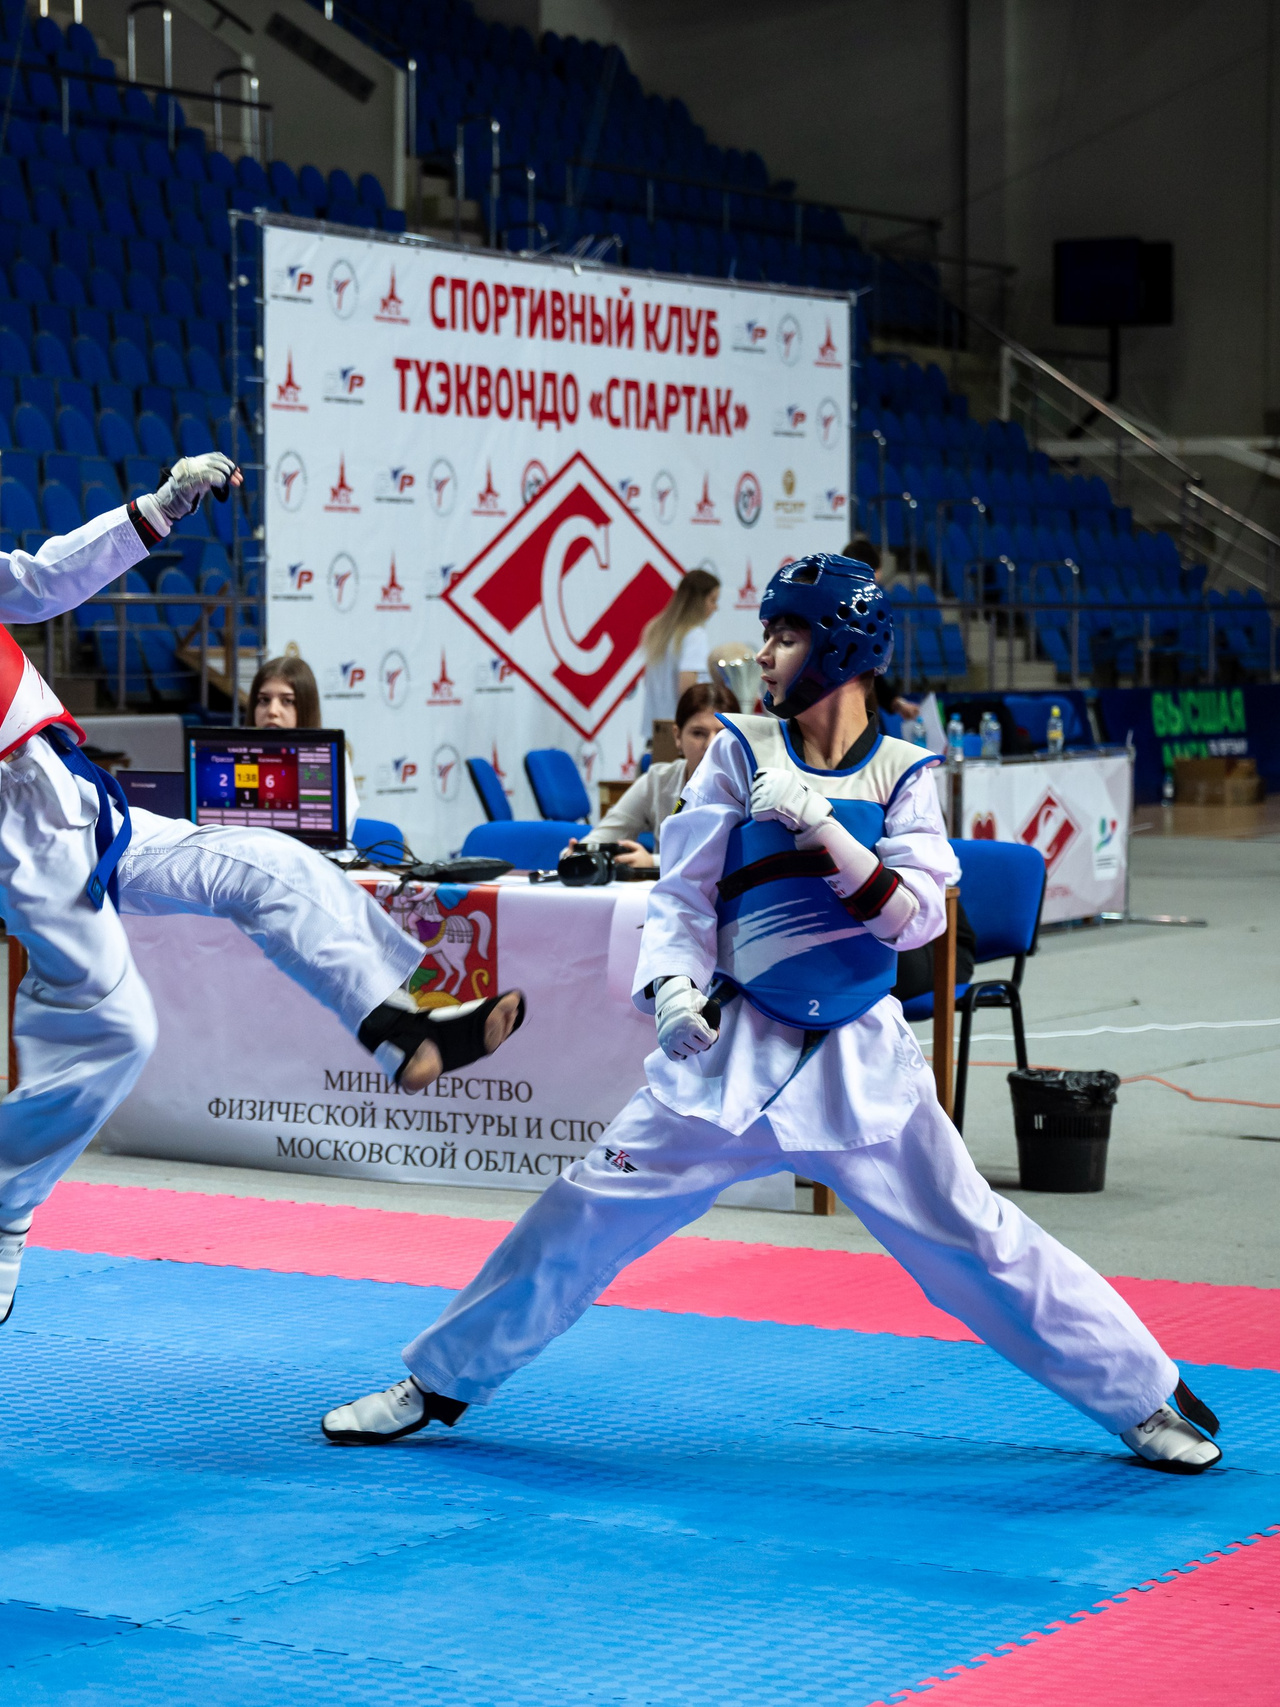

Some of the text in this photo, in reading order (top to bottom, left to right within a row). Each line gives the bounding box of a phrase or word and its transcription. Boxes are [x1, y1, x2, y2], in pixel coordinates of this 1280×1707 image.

[430, 275, 720, 358] СПОРТИВНЫЙ КЛУБ
[393, 357, 750, 437] ТХЭКВОНДО «СПАРТАК»
[219, 773, 228, 787] 2
[265, 774, 275, 788] 6
[808, 999, 820, 1016] 2
[324, 1069, 533, 1104] МИНИЕРСТВО
[207, 1097, 611, 1143] ФИЗИЧЕСКОЙ КУЛЬТУРЫ И СПО
[276, 1136, 457, 1170] МОСКОВСКОЙ
